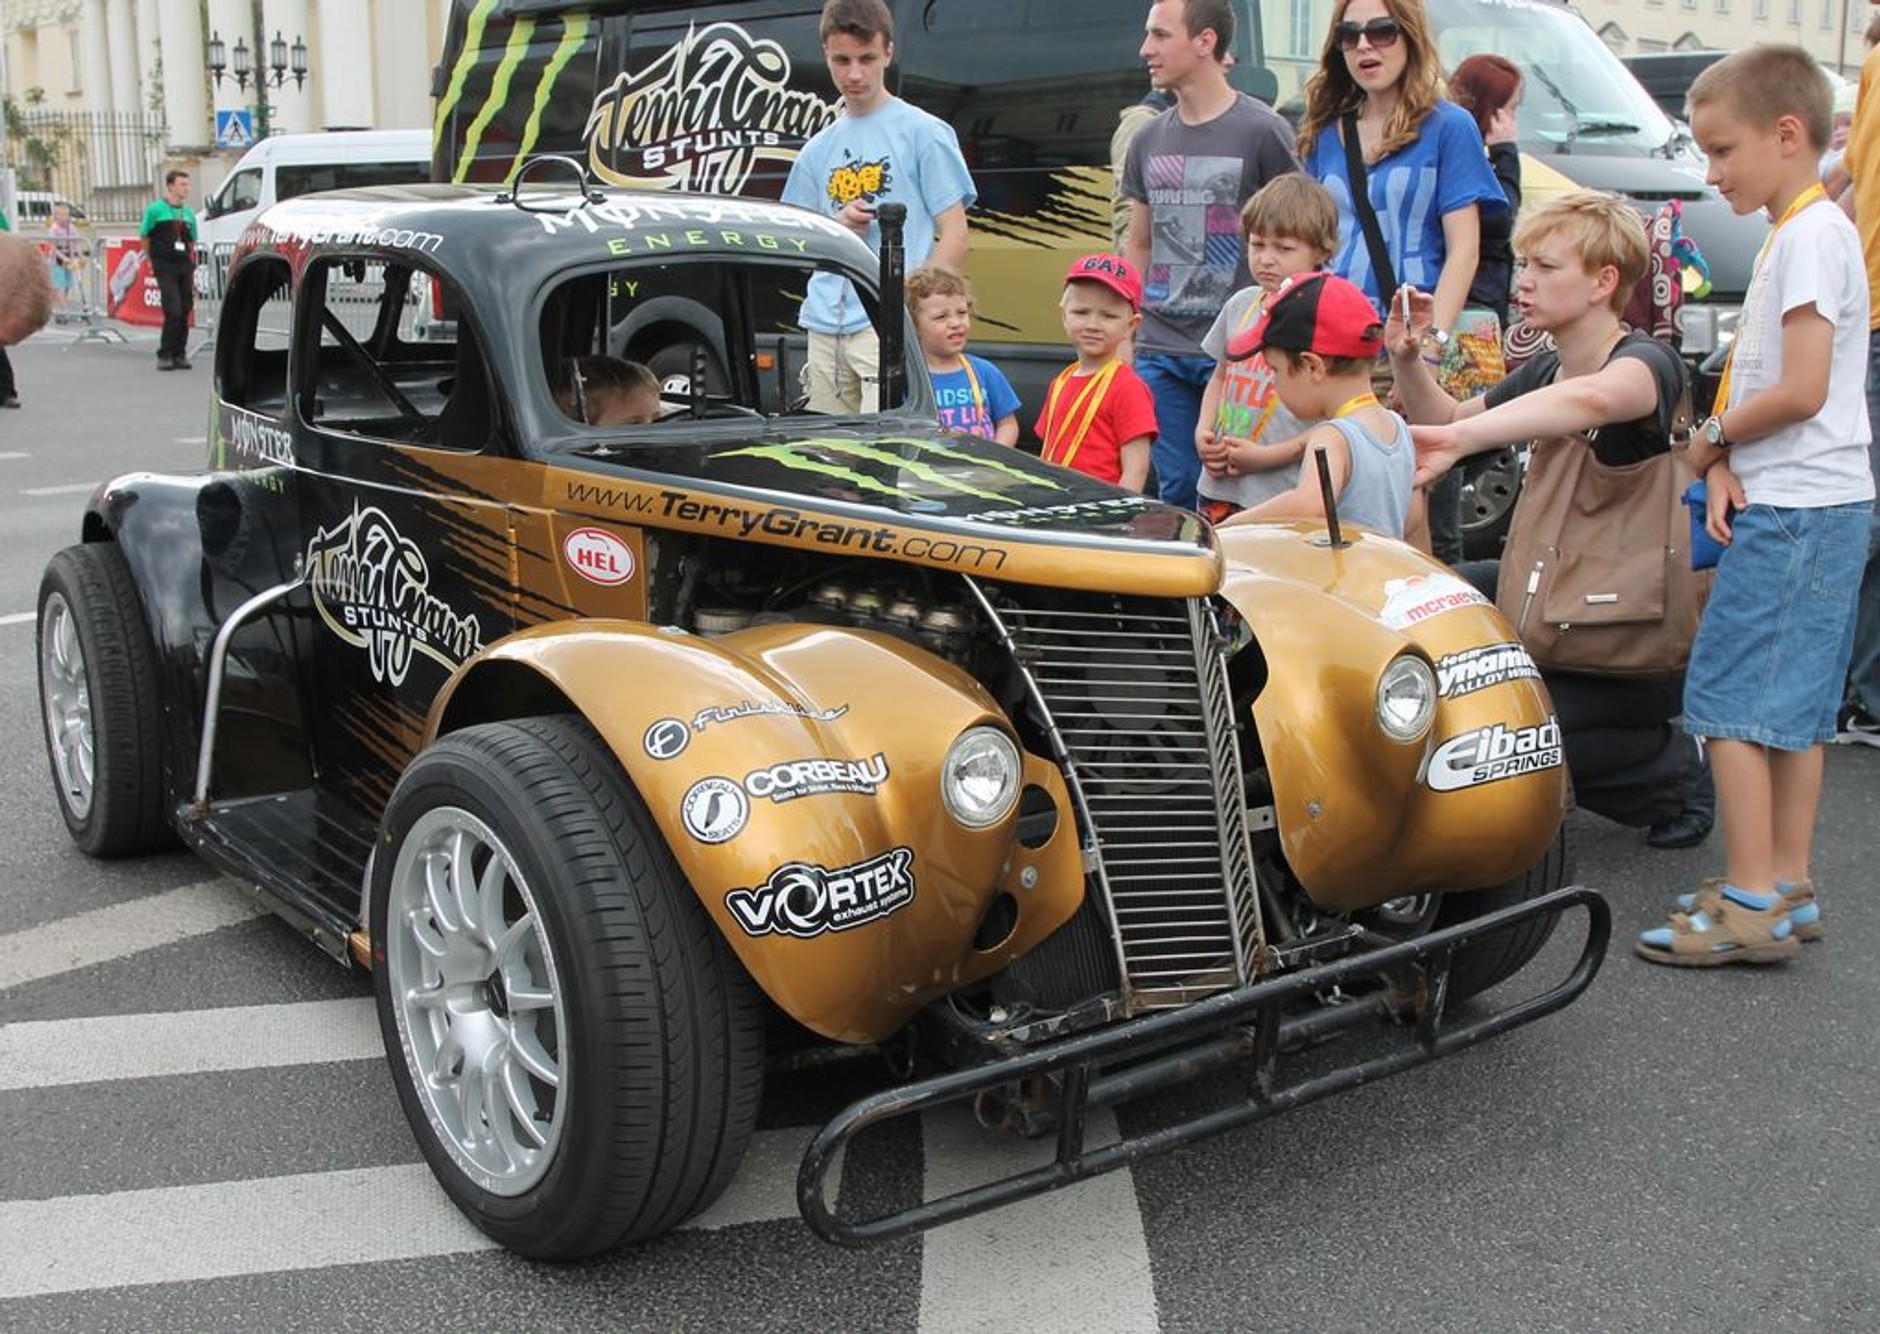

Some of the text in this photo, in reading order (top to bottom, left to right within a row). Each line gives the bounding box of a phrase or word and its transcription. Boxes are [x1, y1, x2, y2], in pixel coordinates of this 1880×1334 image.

[643, 130, 780, 170] STUNTS
[607, 229, 808, 256] ENERGY
[1084, 258, 1127, 278] GAP
[567, 482, 1007, 570] www.TerryGrant.com
[577, 547, 622, 575] HEL
[344, 605, 428, 643] STUNTS
[1454, 672, 1505, 697] ALLOY
[1428, 714, 1561, 790] Eibach
[1473, 749, 1559, 782] SPRINGS
[745, 755, 888, 796] CORBEAU
[735, 853, 907, 928] VORTEX
[833, 900, 878, 922] exhaust
